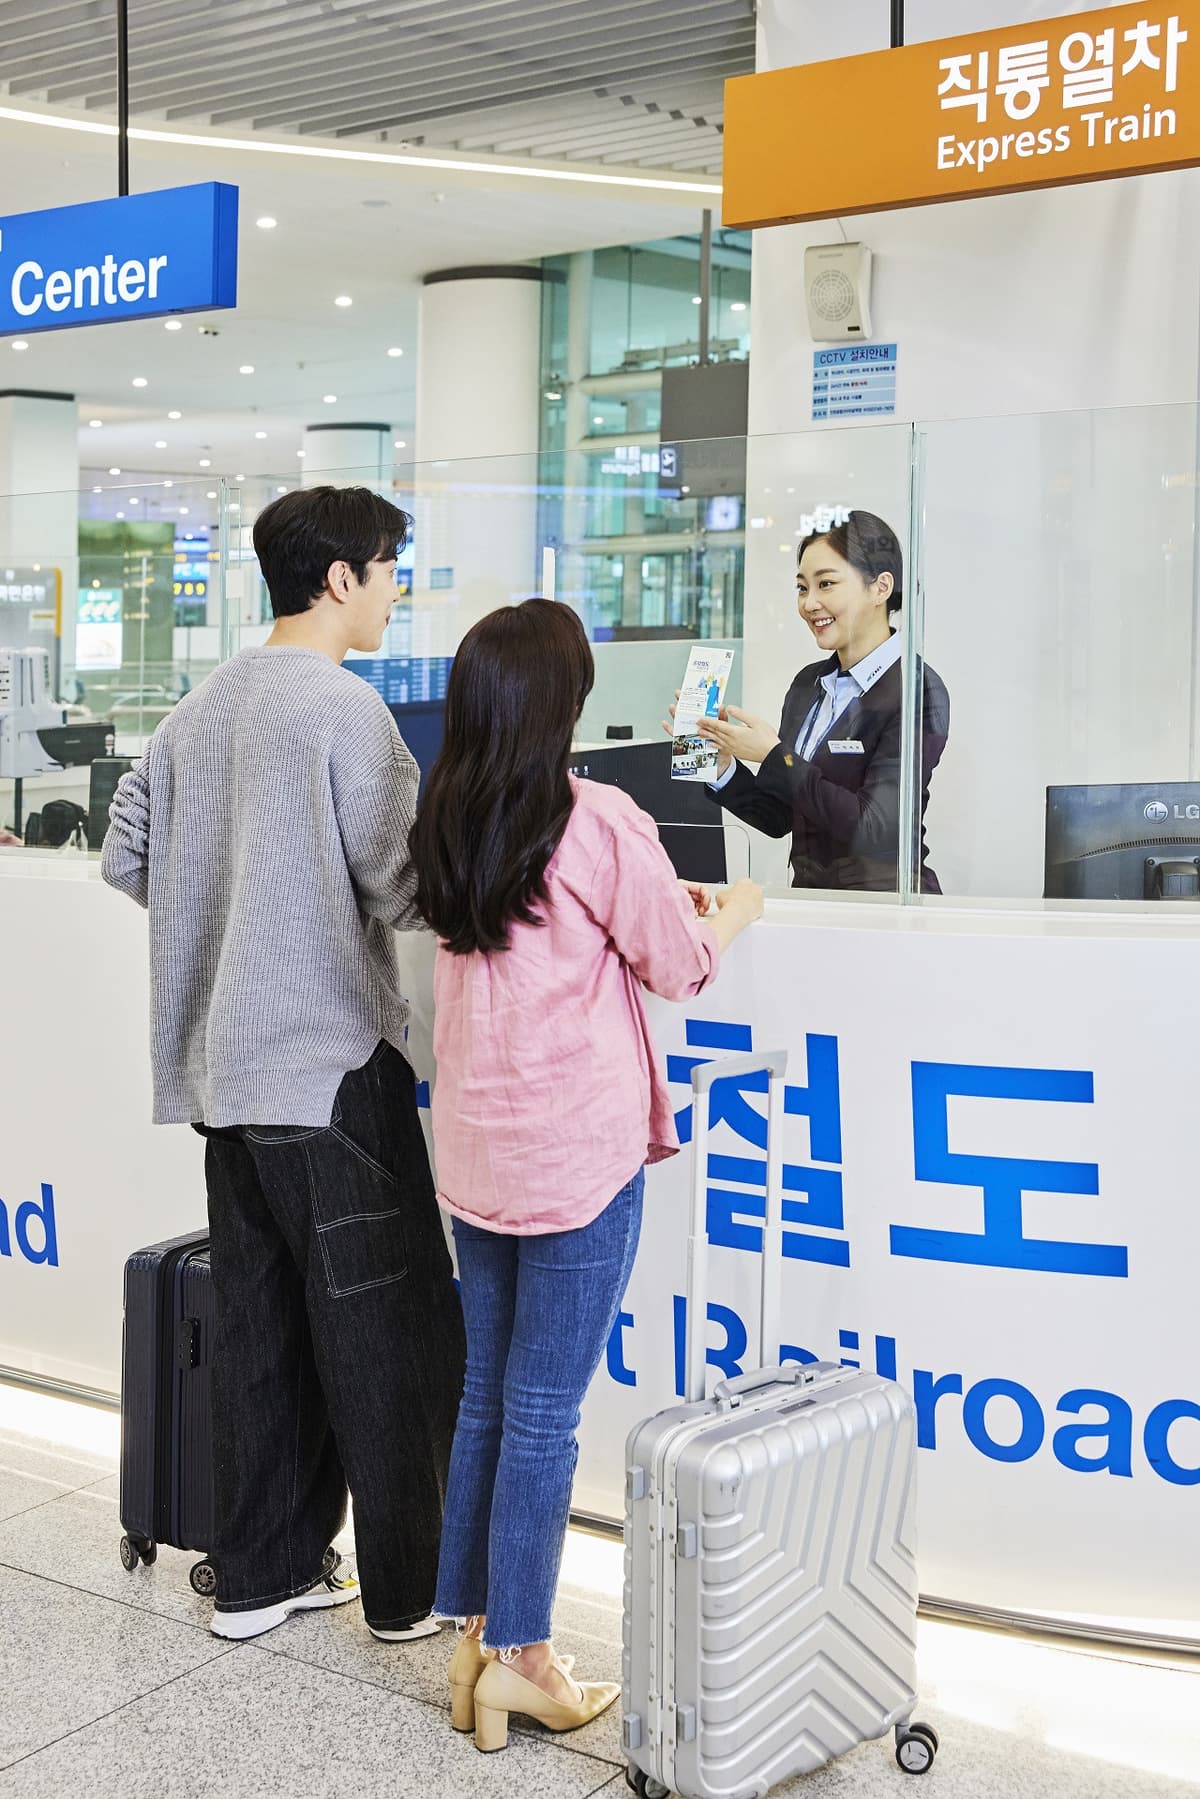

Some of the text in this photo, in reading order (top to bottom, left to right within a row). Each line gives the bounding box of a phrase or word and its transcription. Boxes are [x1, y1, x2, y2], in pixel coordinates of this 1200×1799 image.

[937, 15, 1188, 124] 직통열차
[937, 103, 1177, 173] Express Train
[11, 254, 168, 316] Center
[820, 347, 889, 364] CCTV 설치안내
[1173, 804, 1200, 819] LG
